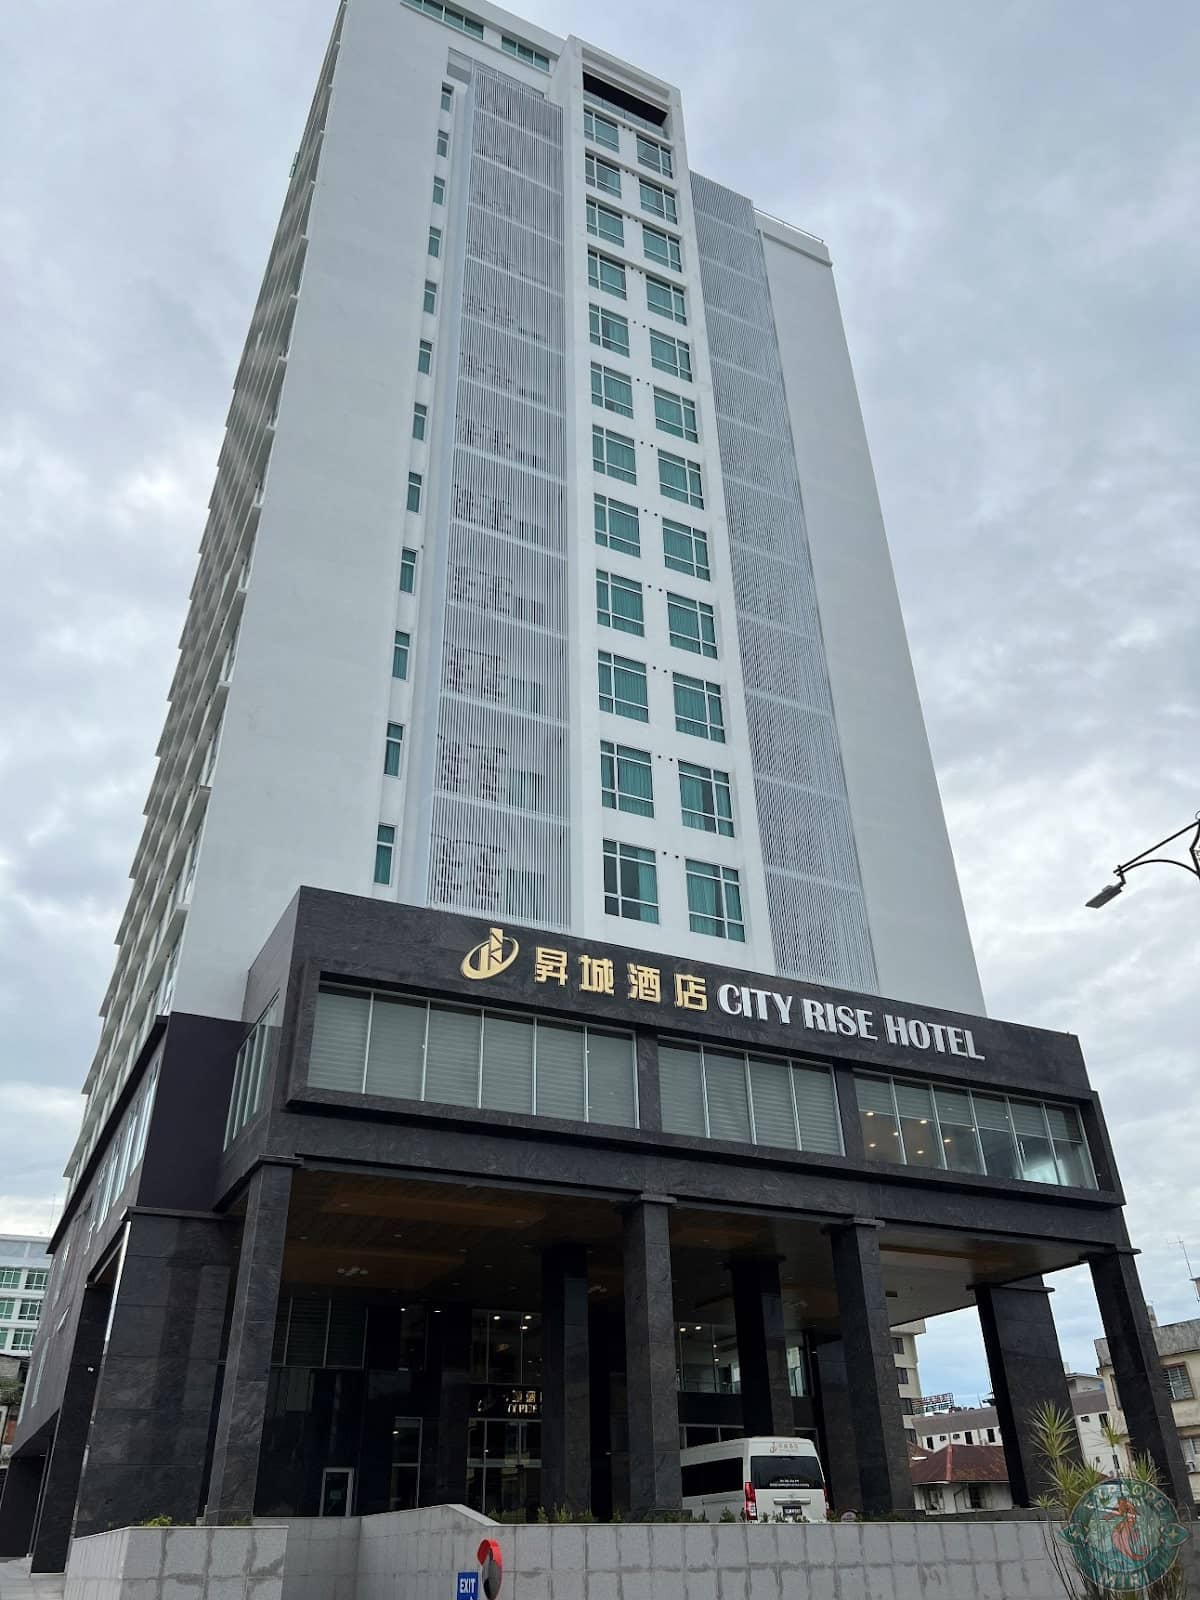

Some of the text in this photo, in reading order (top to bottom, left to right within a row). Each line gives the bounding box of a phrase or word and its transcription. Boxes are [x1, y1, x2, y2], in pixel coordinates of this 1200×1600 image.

[534, 946, 707, 1012] 昇城酒店
[717, 983, 986, 1061] CITY RISE HOTEL
[460, 1578, 476, 1593] EXIT
